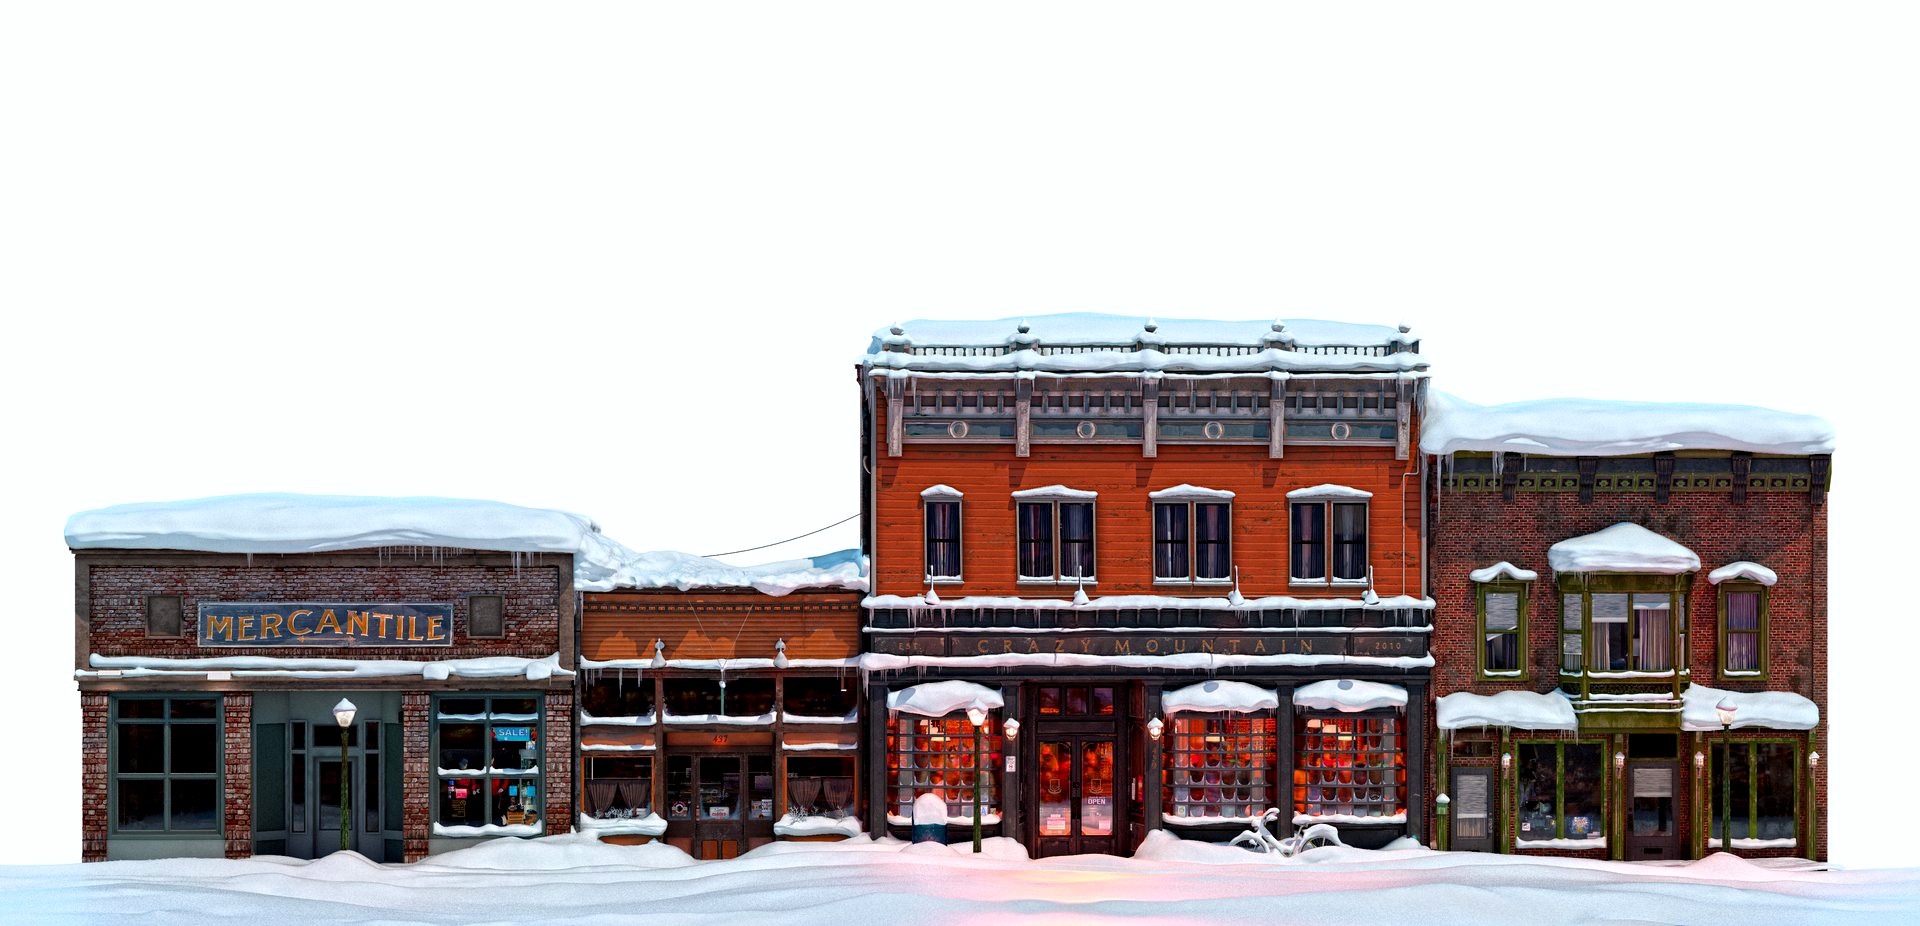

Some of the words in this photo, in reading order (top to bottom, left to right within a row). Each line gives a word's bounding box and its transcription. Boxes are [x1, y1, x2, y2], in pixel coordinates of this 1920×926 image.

[206, 608, 446, 642] MERCANTILE
[977, 639, 1091, 653] CRAZY
[1115, 639, 1313, 653] MOUNTAIN
[1375, 642, 1401, 650] 2010
[498, 728, 528, 736] SALE!
